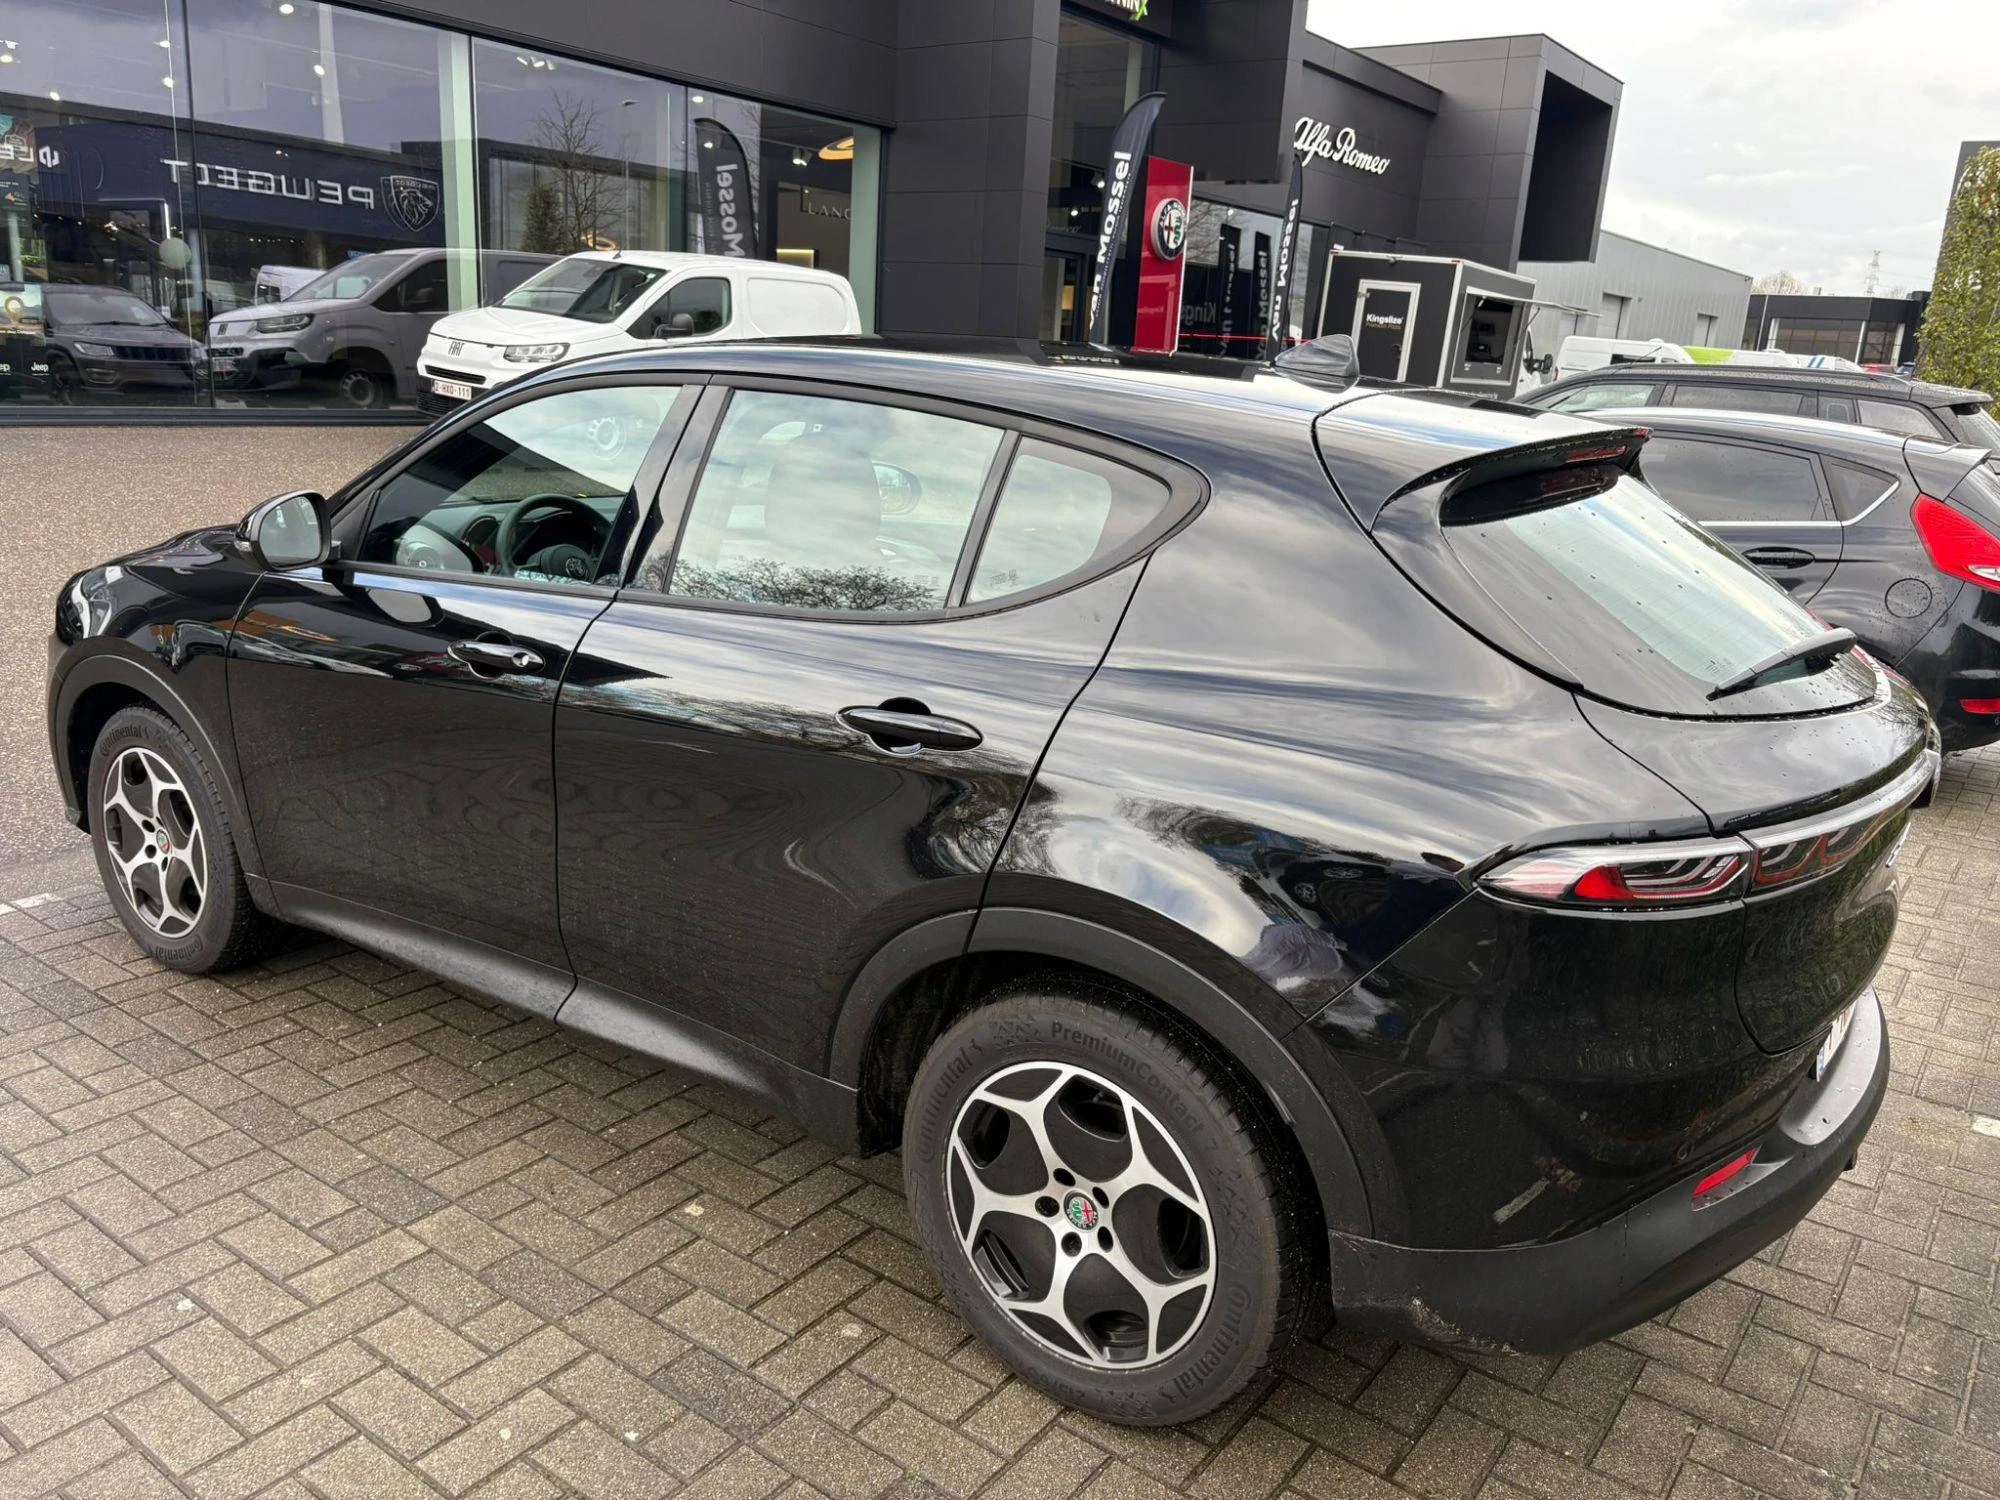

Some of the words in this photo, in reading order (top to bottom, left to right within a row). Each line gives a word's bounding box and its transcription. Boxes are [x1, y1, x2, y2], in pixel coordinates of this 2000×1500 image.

[1293, 116, 1333, 167] Alfa
[1332, 127, 1391, 174] Romeo
[1097, 151, 1132, 264] Mossel
[31, 361, 49, 373] Jeep
[448, 340, 465, 357] FIAT
